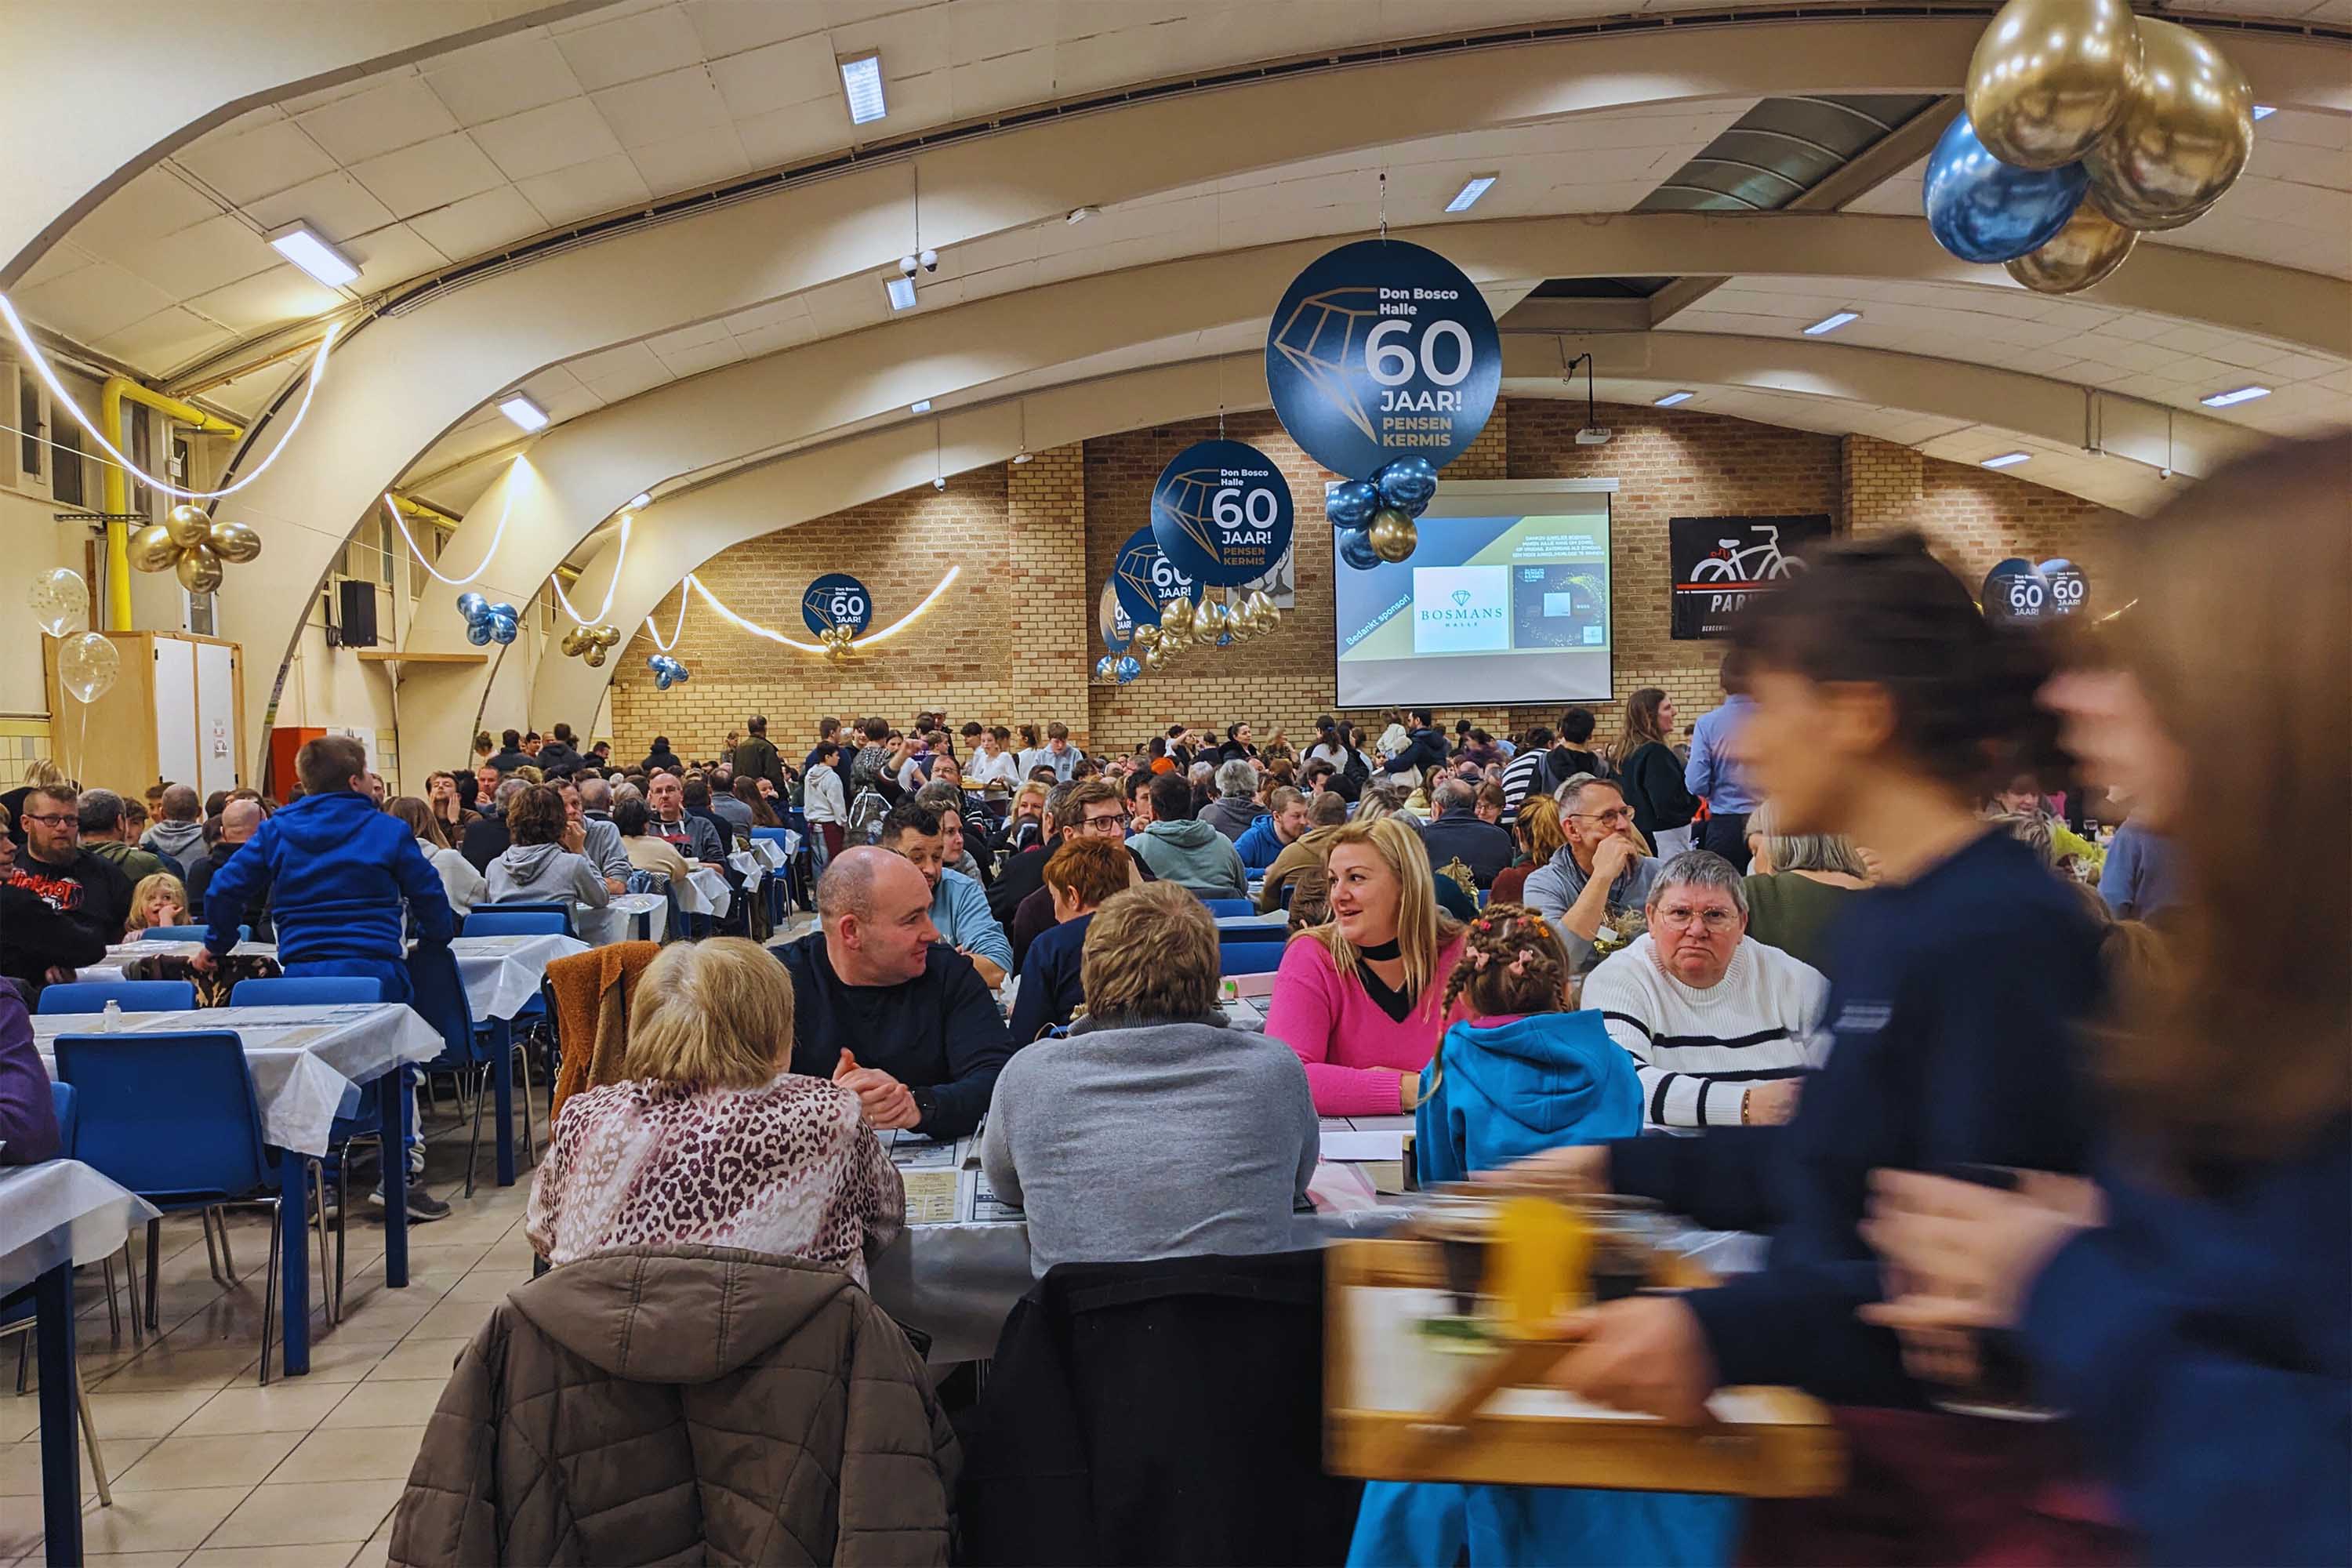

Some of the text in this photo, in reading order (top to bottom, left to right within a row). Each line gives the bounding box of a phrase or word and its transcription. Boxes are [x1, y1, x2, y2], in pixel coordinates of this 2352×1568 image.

[1380, 288, 1458, 299] Don Bosco
[1380, 303, 1417, 315] Halle
[1365, 320, 1473, 386] 60
[1380, 391, 1462, 412] JAAR!
[1383, 417, 1451, 430] PENSEN
[1383, 434, 1451, 447] KERMIS
[1212, 488, 1278, 528] 60
[1221, 532, 1272, 544] JAAR!
[1224, 547, 1265, 556] PENSEN
[1158, 586, 1192, 598] JAAR!
[2053, 580, 2083, 599] 60
[2010, 585, 2043, 608] 60
[831, 596, 864, 616] 60
[1421, 608, 1503, 621] BOSMANS
[1116, 620, 1132, 630] JAAR!
[1345, 619, 1379, 645] Bedankt
